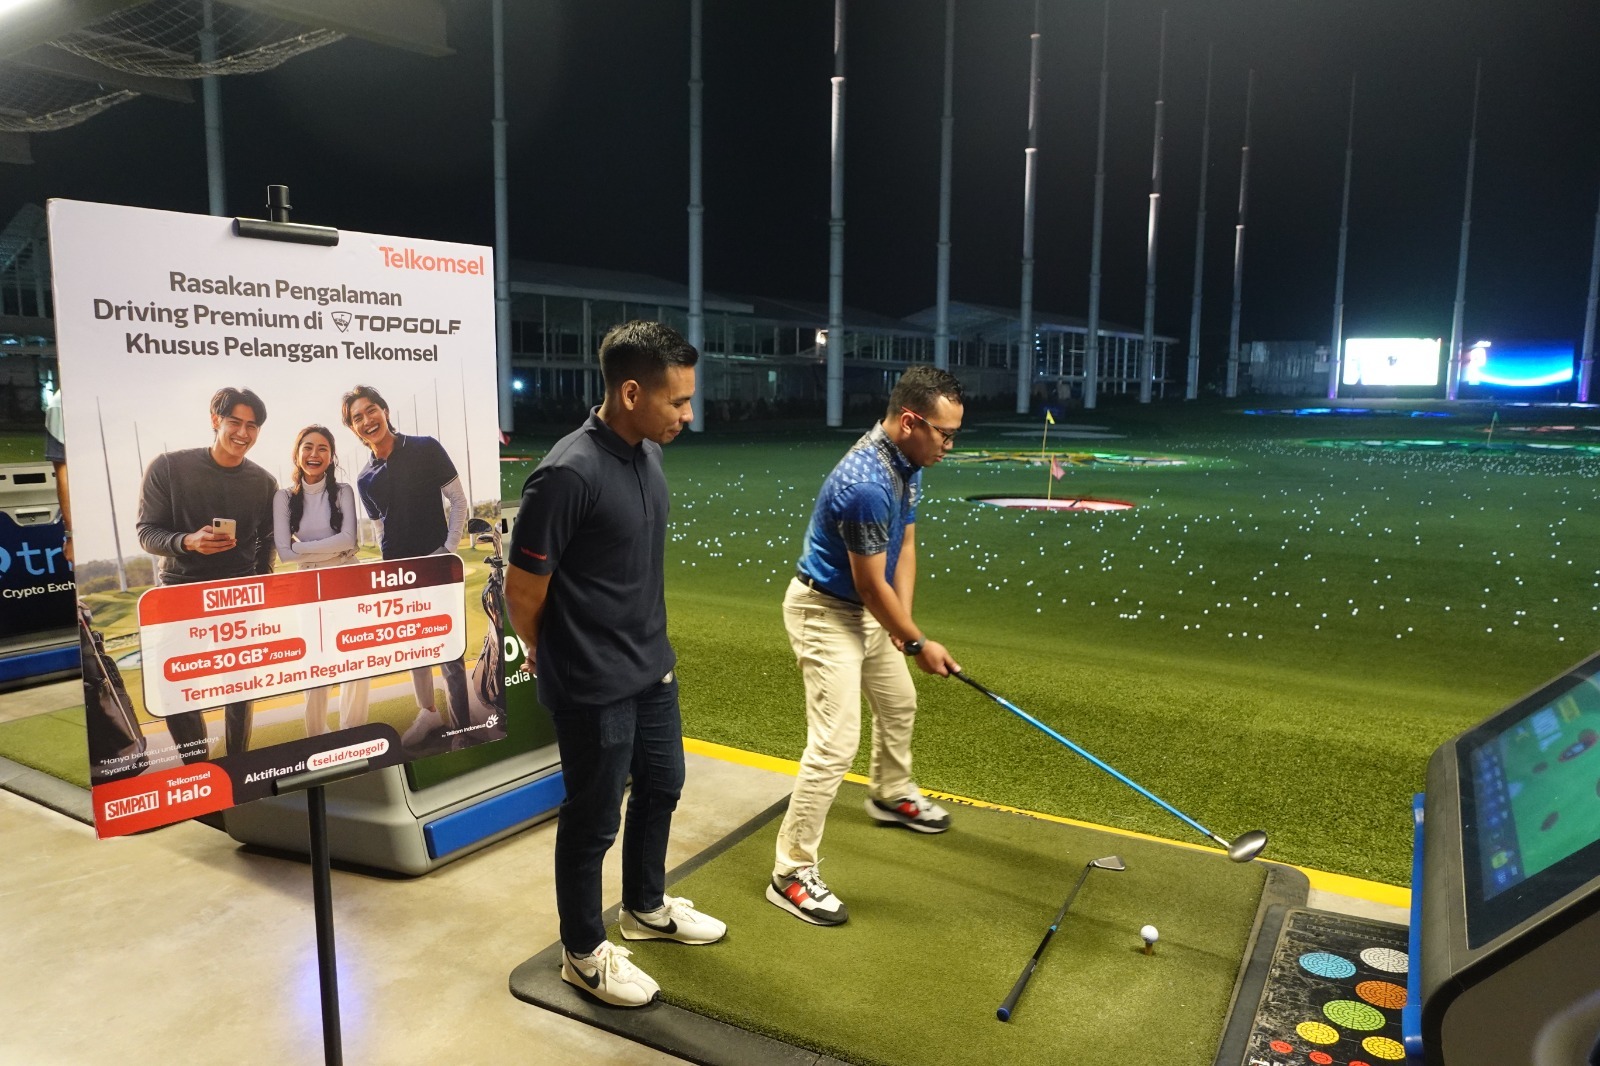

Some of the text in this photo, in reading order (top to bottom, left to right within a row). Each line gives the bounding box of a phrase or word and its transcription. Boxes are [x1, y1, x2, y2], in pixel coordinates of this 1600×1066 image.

[379, 246, 485, 275] Telkomsel
[169, 271, 402, 306] Rasakan Pengalaman
[93, 298, 462, 335] Driving Premium di TOPGOLF
[125, 332, 438, 363] Khusus Pelanggan Telkomsel
[371, 567, 417, 589] Halo
[2, 586, 45, 599] Crypto
[205, 584, 263, 610] SIMPATI
[406, 600, 432, 614] ribu
[250, 623, 281, 638] ribu
[341, 631, 375, 645] Kuota
[375, 627, 395, 642] 30
[433, 624, 448, 633] Hari
[171, 658, 212, 674] Kuota
[212, 652, 236, 670] 30
[284, 648, 302, 658] Hari
[181, 675, 264, 702] Termasuk
[265, 673, 275, 687] 2
[276, 669, 308, 686] Jam
[310, 658, 365, 679] Regular
[367, 653, 392, 669] Bay
[131, 748, 160, 759] berlaku
[160, 743, 182, 753] untuk
[183, 735, 220, 749] weekdays
[131, 762, 138, 770] &
[138, 754, 179, 768] Ketentuan
[179, 747, 207, 759] berlaku
[244, 741, 385, 785] Aktifkan di tsel.id/topgolf
[166, 770, 211, 787] Telkomsel
[106, 783, 212, 819] SIMPATI Halo
